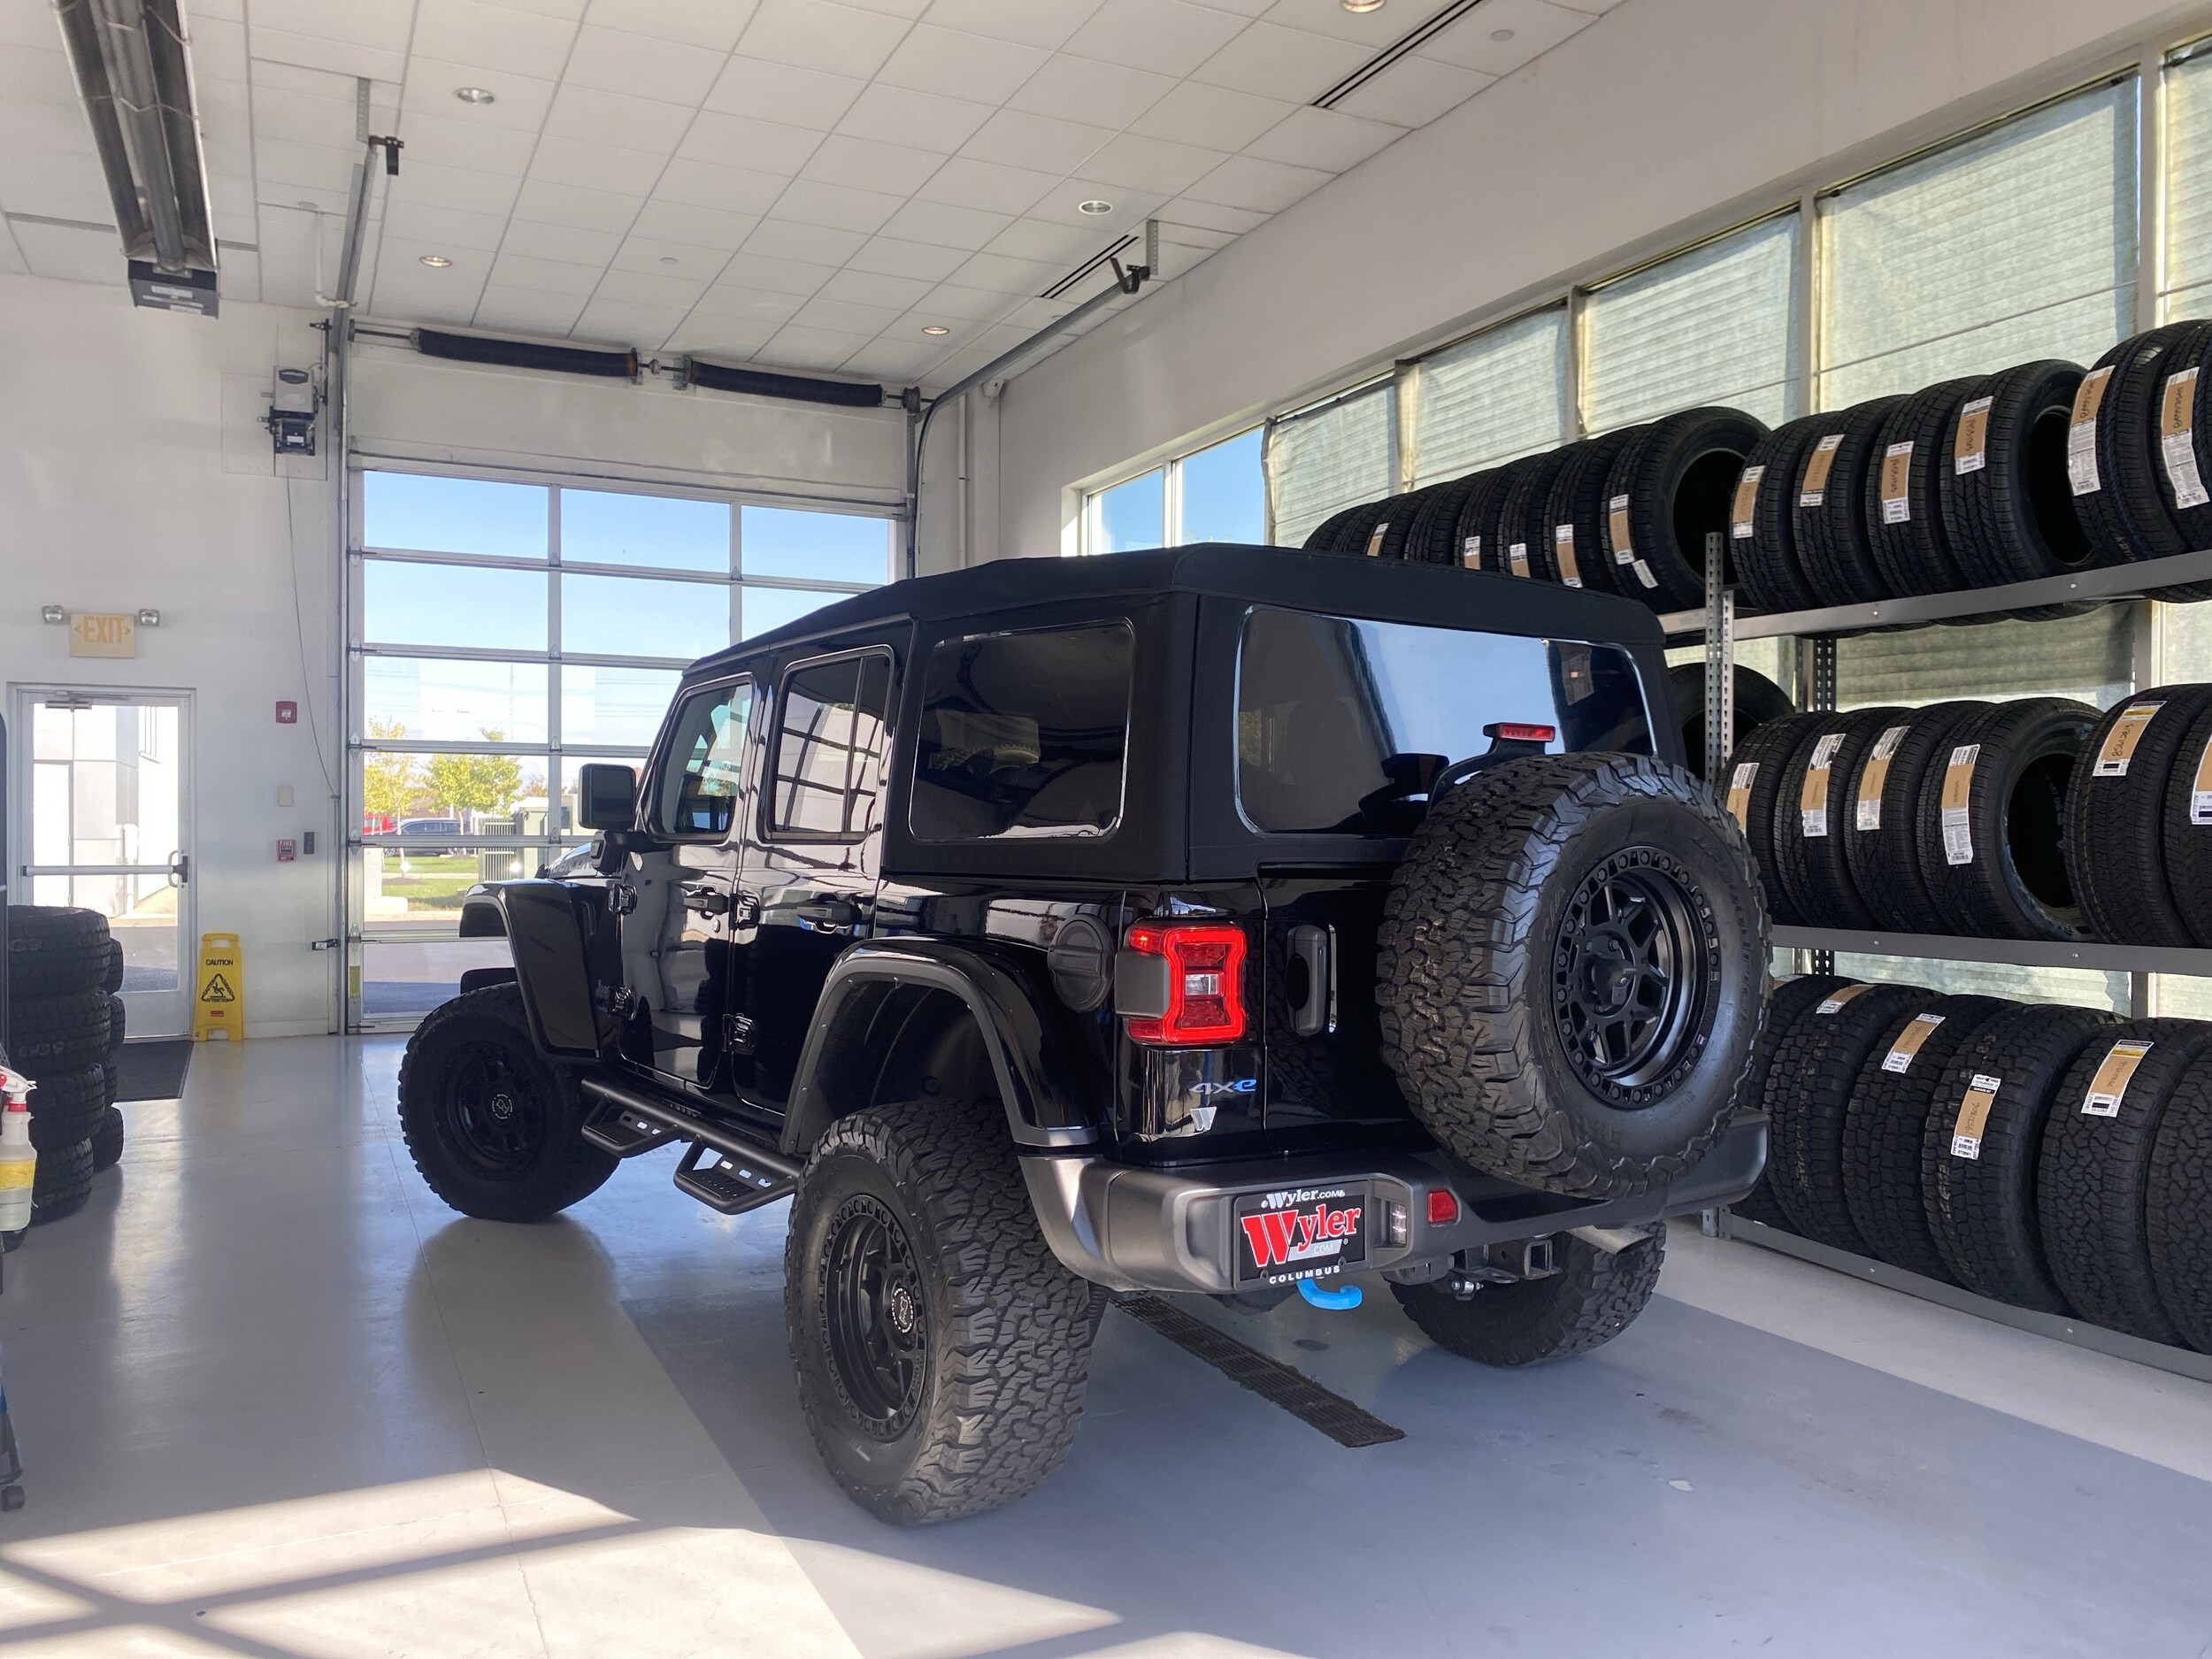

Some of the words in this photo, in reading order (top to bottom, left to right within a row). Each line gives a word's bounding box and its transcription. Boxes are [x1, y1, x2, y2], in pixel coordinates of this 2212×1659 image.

[83, 615, 124, 644] EXIT
[1240, 1203, 1362, 1267] Wyler
[1269, 1264, 1340, 1285] COLUMBUS
